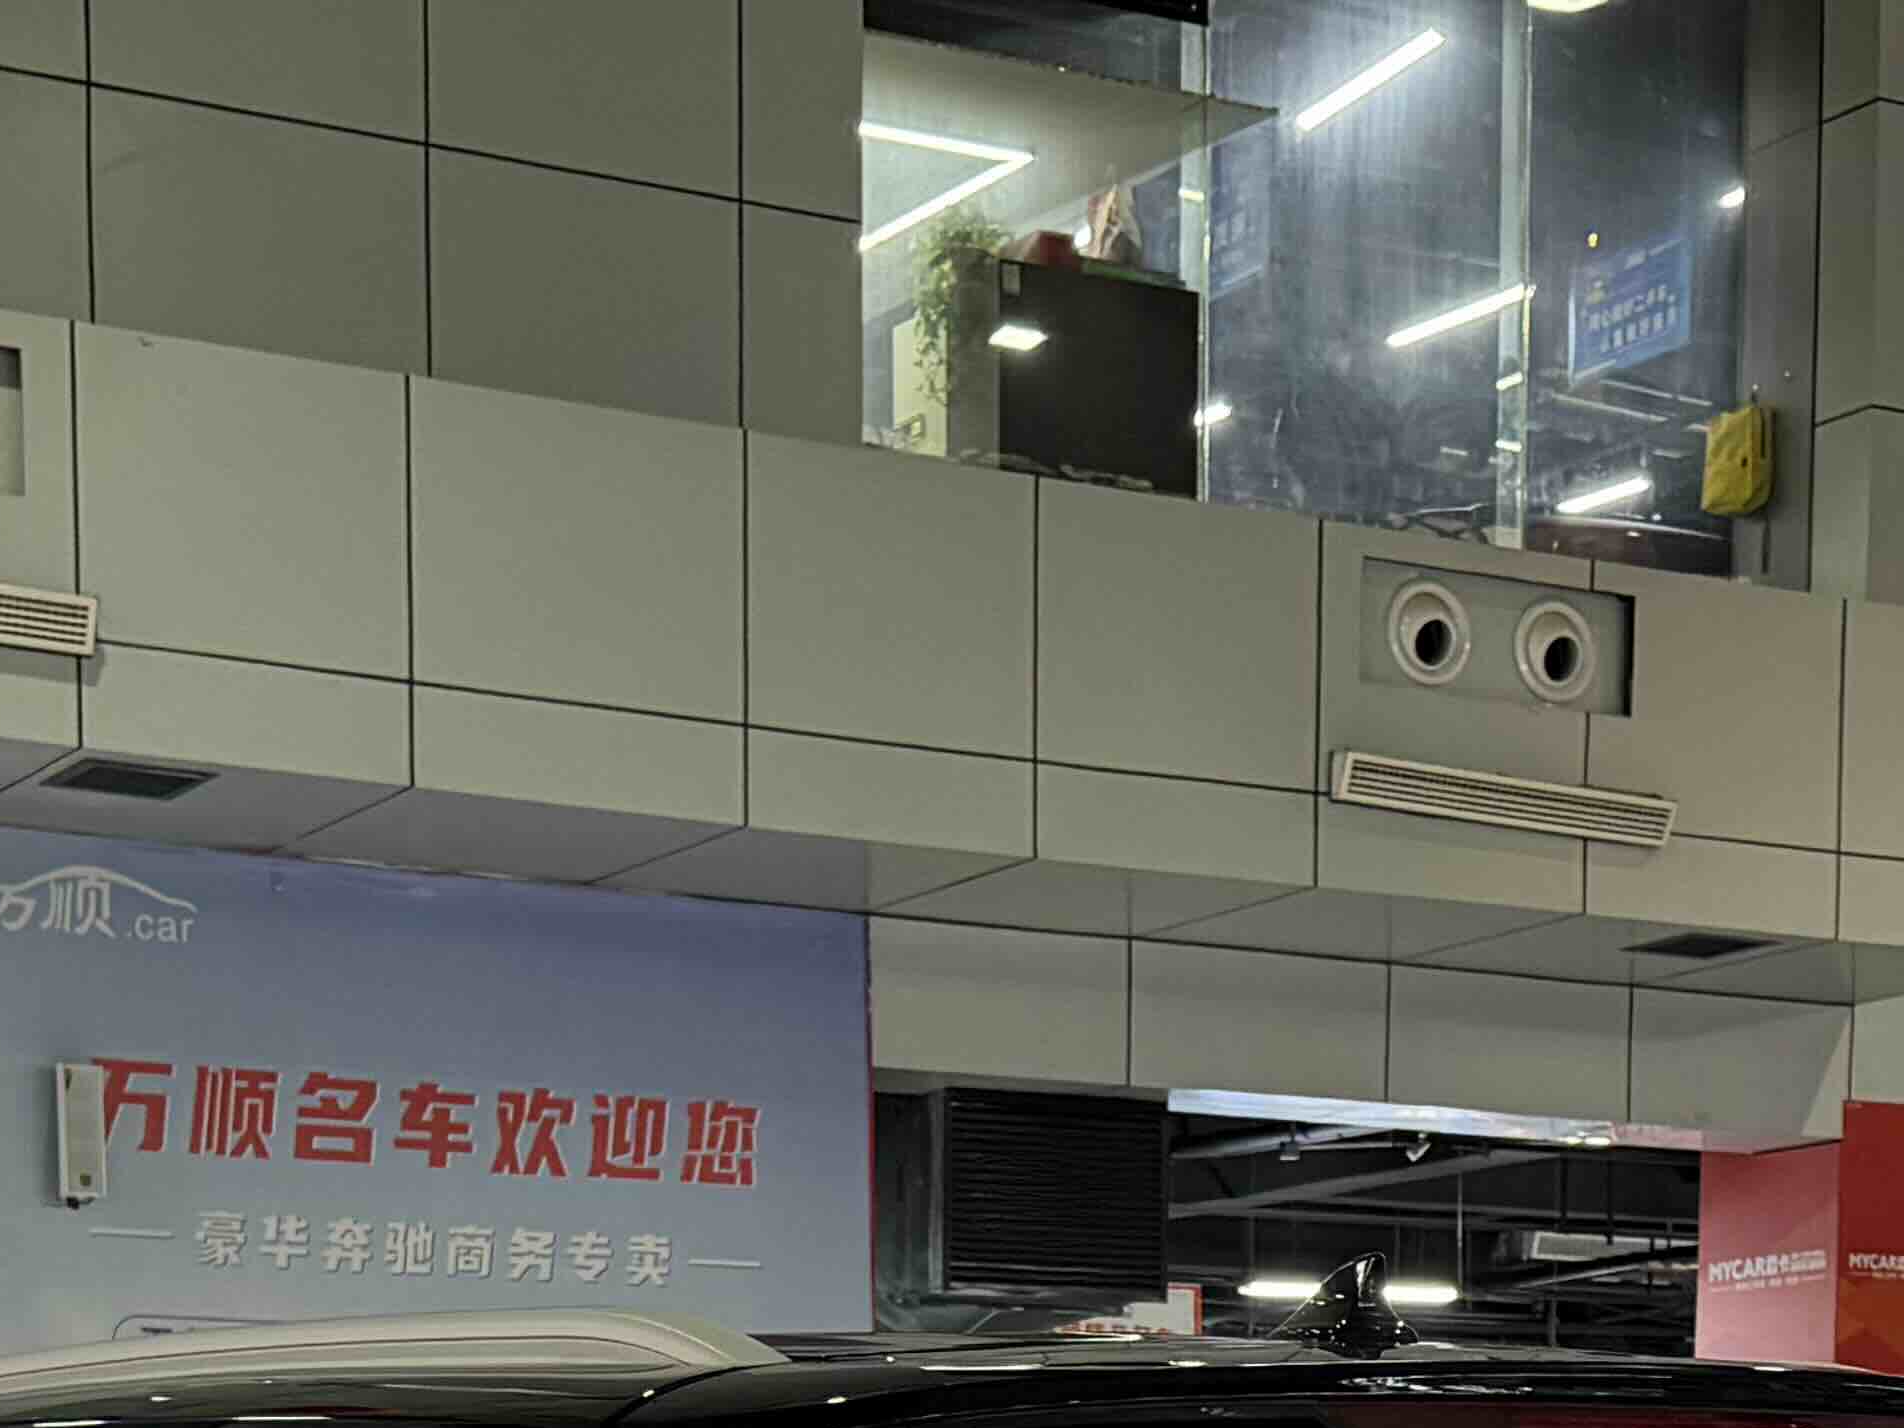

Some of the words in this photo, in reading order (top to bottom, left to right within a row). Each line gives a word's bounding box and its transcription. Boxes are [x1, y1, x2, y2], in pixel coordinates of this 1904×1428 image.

[90, 1057, 763, 1189] 万顺名车欢迎您
[194, 1208, 675, 1287] 豪华奔驰商务专卖
